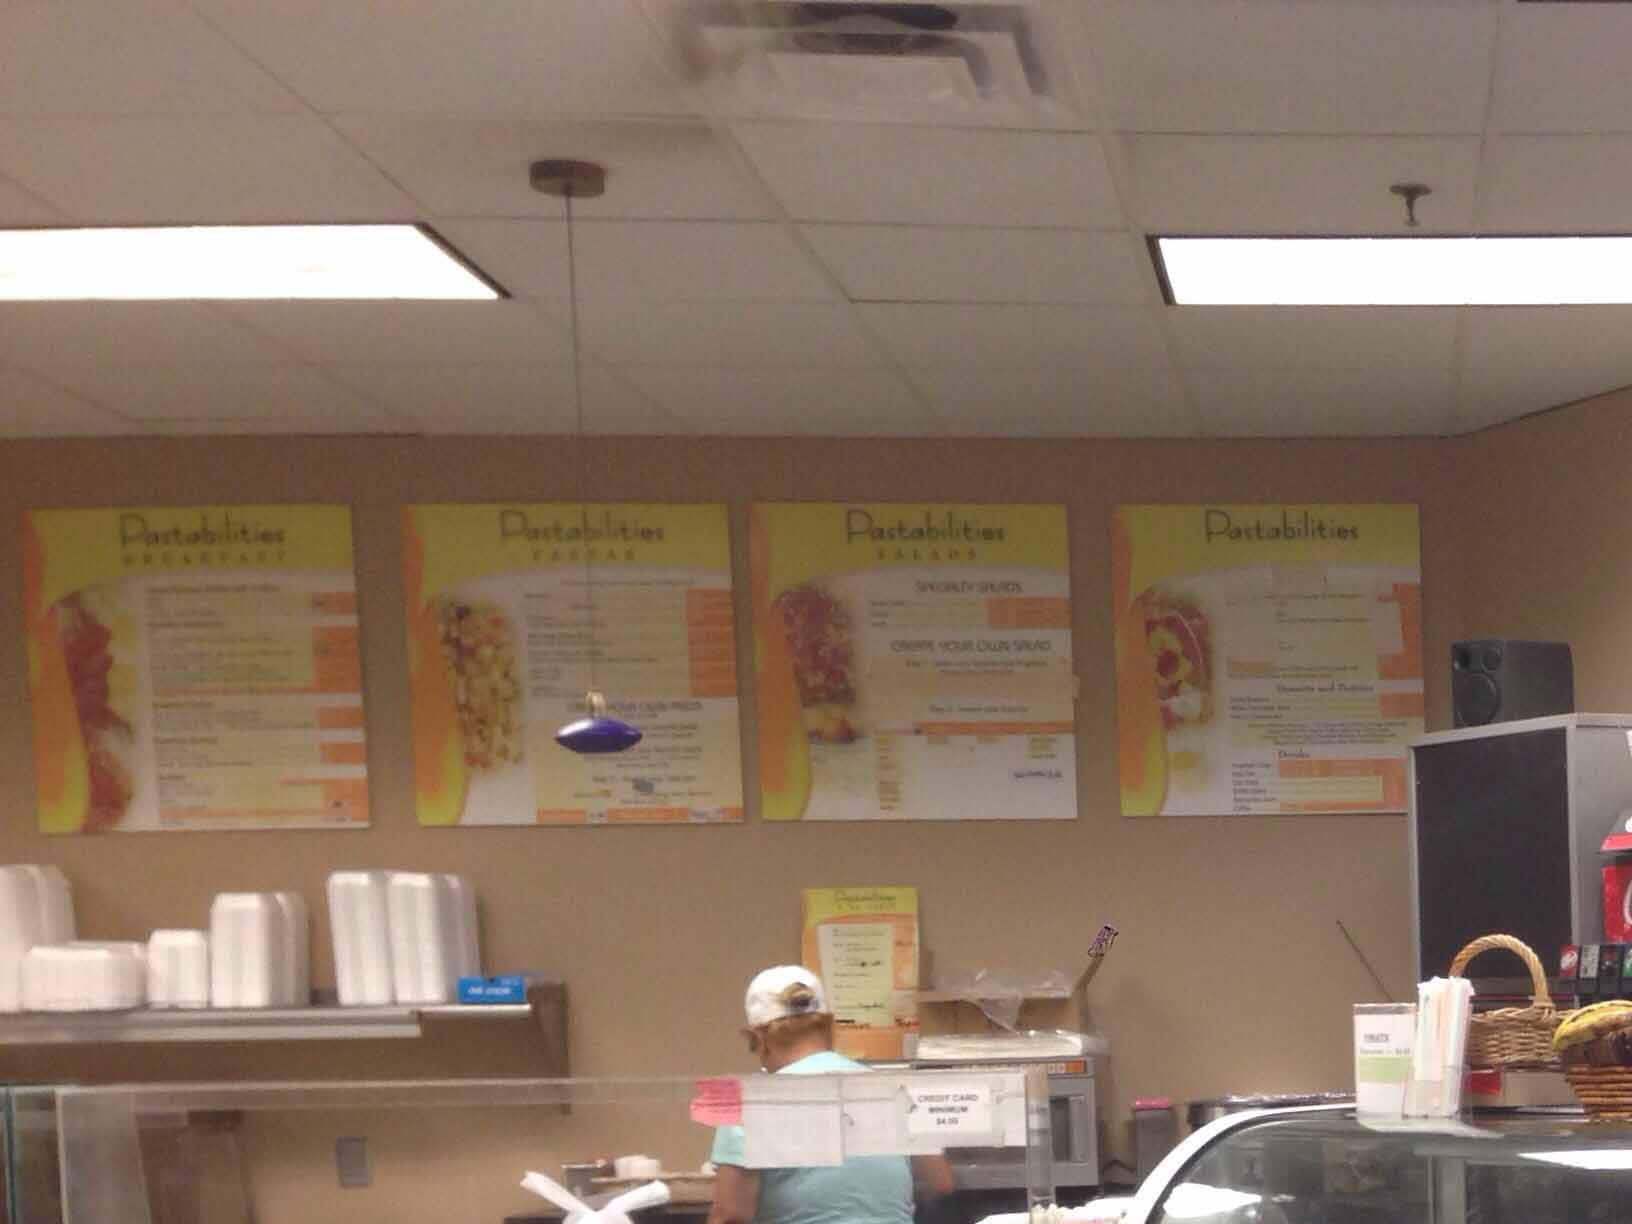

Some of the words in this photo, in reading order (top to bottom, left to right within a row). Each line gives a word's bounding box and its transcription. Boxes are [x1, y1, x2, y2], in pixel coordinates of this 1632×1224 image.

[119, 511, 286, 547] Pastabilities
[501, 510, 664, 543] Pastabilities
[847, 509, 1006, 543] Pastabilities
[1205, 509, 1359, 543] Pastabilities
[952, 1093, 978, 1102] CARD
